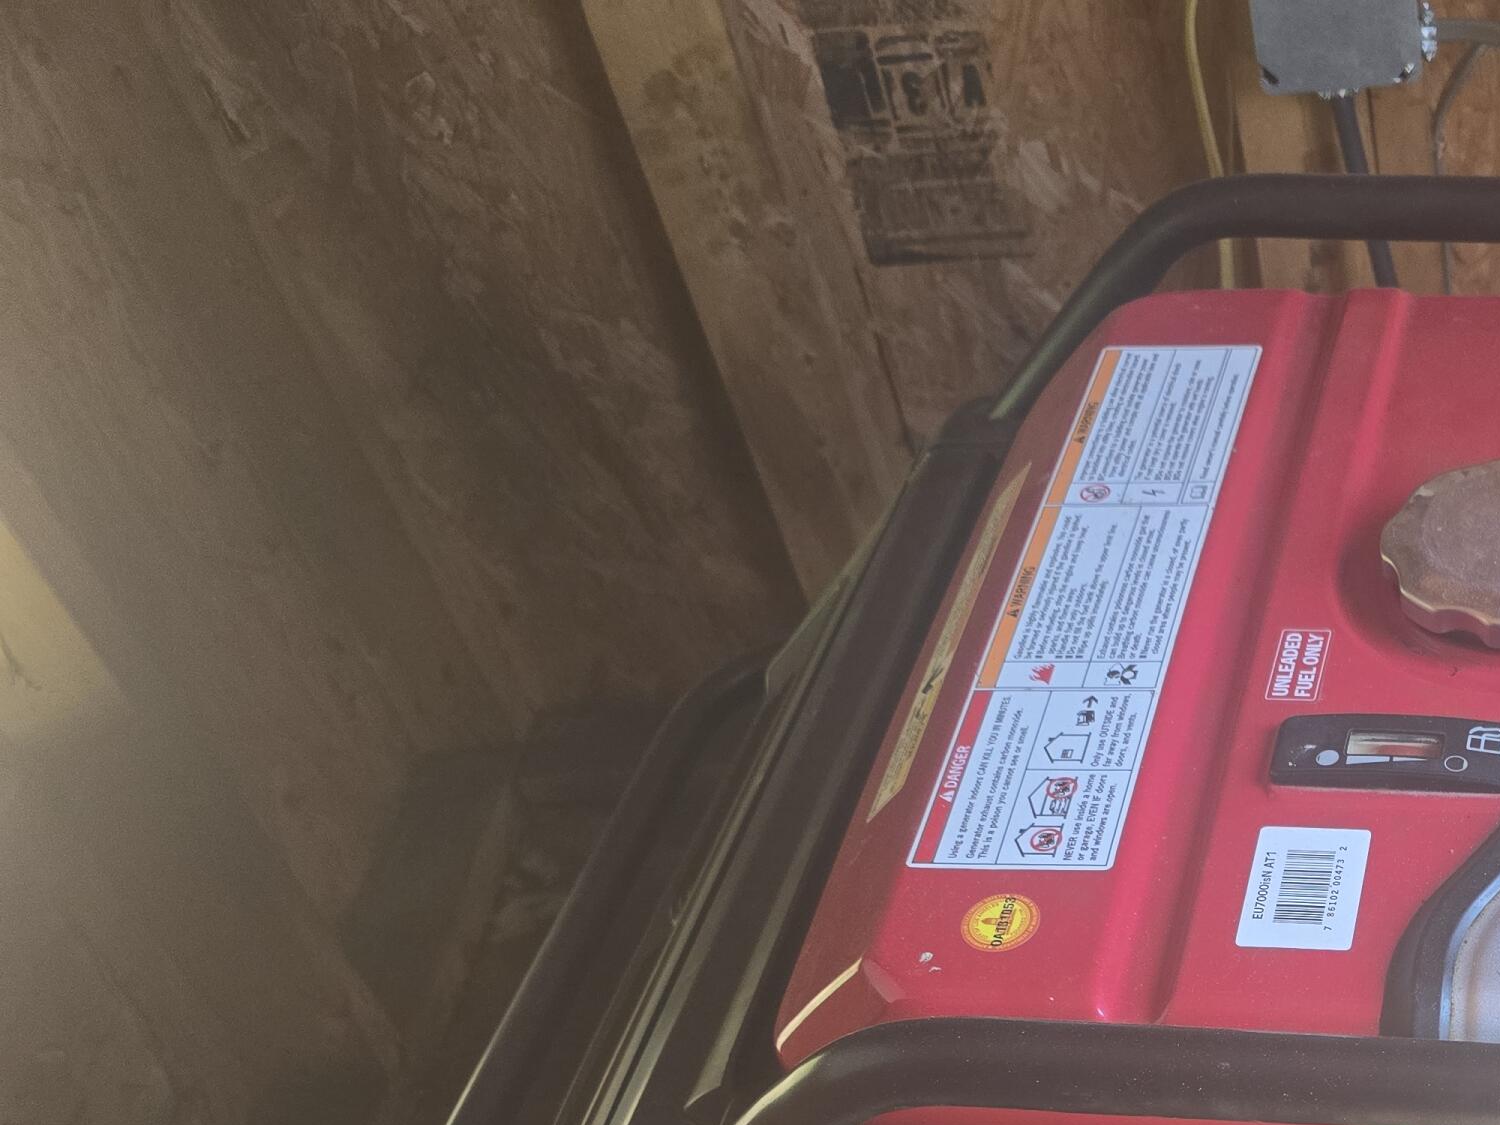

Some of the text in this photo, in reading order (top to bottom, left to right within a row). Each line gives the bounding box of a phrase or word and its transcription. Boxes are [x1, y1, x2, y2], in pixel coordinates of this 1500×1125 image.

[1009, 566, 1035, 607] WARNING
[1271, 632, 1303, 695] UNLEADED
[1293, 633, 1325, 696] FUEL ONLY
[986, 732, 999, 744] YOU
[1089, 696, 1118, 766] Only use OUTSIDE and
[1110, 722, 1123, 737] from
[981, 747, 994, 759] KILL
[1106, 739, 1119, 755] away
[1113, 747, 1127, 766] doors,
[1120, 732, 1131, 744] and
[943, 745, 971, 787] DANGER
[975, 761, 989, 774] CAN
[1009, 754, 1019, 765] see
[1102, 757, 1113, 766] far
[967, 776, 984, 799] indoors
[1000, 767, 1015, 789] cannot
[1082, 774, 1096, 792] home
[1094, 774, 1108, 793] doors
[964, 823, 986, 858] Generator
[977, 794, 995, 821] exhaust
[987, 766, 1005, 793] contains
[996, 742, 1012, 764] carbon
[996, 791, 1009, 803] you
[956, 802, 977, 832] generator
[986, 806, 1004, 828] poison
[1073, 800, 1088, 820] inside
[1085, 803, 1100, 821] EVEN
[1101, 803, 1112, 814] are
[1071, 823, 1082, 834] use
[1077, 823, 1096, 850] garage,
[1091, 817, 1108, 845] windows
[947, 840, 963, 858] Using
[976, 844, 990, 858] This
[1061, 836, 1078, 860] NEVER
[1088, 847, 1099, 860] and
[1331, 859, 1344, 886] 00473
[1251, 851, 1277, 919] EU7000isN AT1
[1325, 889, 1339, 917] 86102
